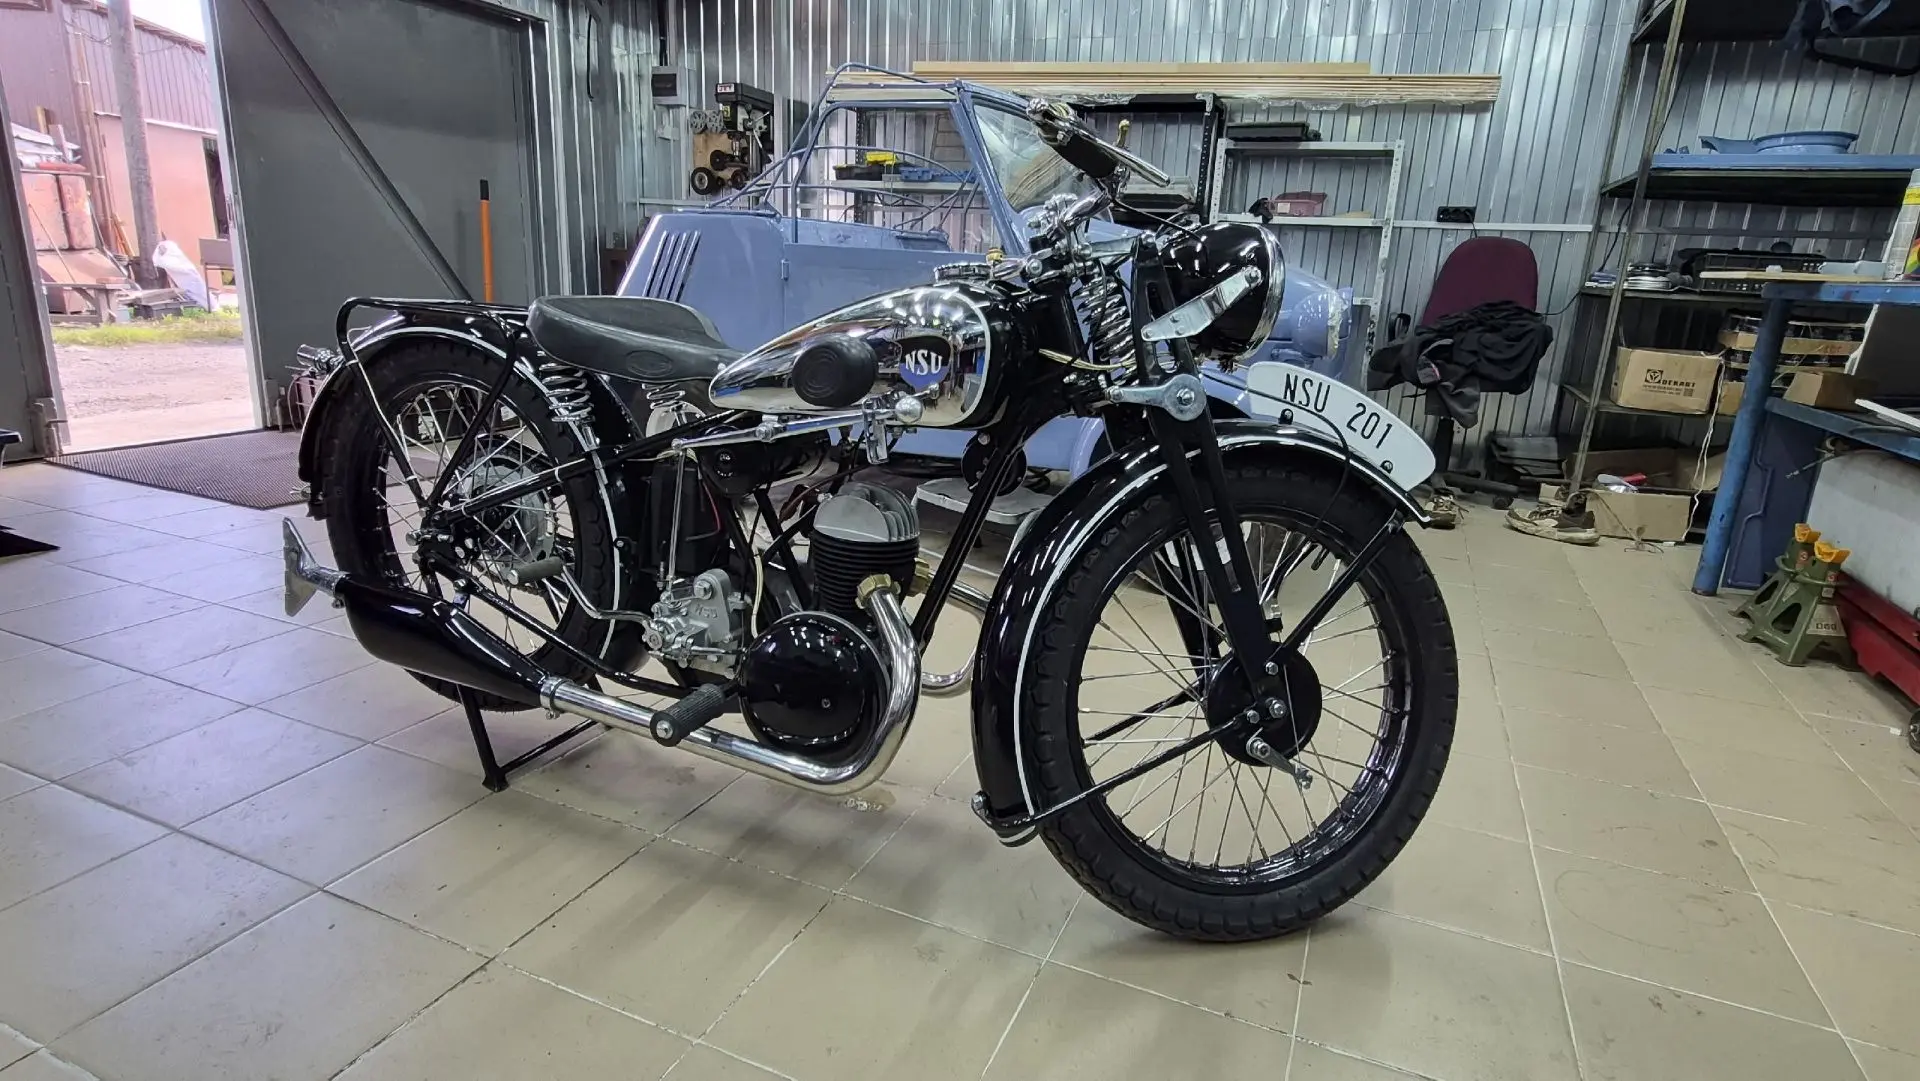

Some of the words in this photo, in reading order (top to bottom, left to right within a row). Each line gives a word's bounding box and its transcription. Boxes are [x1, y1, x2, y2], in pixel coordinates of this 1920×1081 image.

[905, 349, 943, 376] NSU
[1283, 373, 1331, 413] NSU
[1346, 402, 1393, 449] 201
